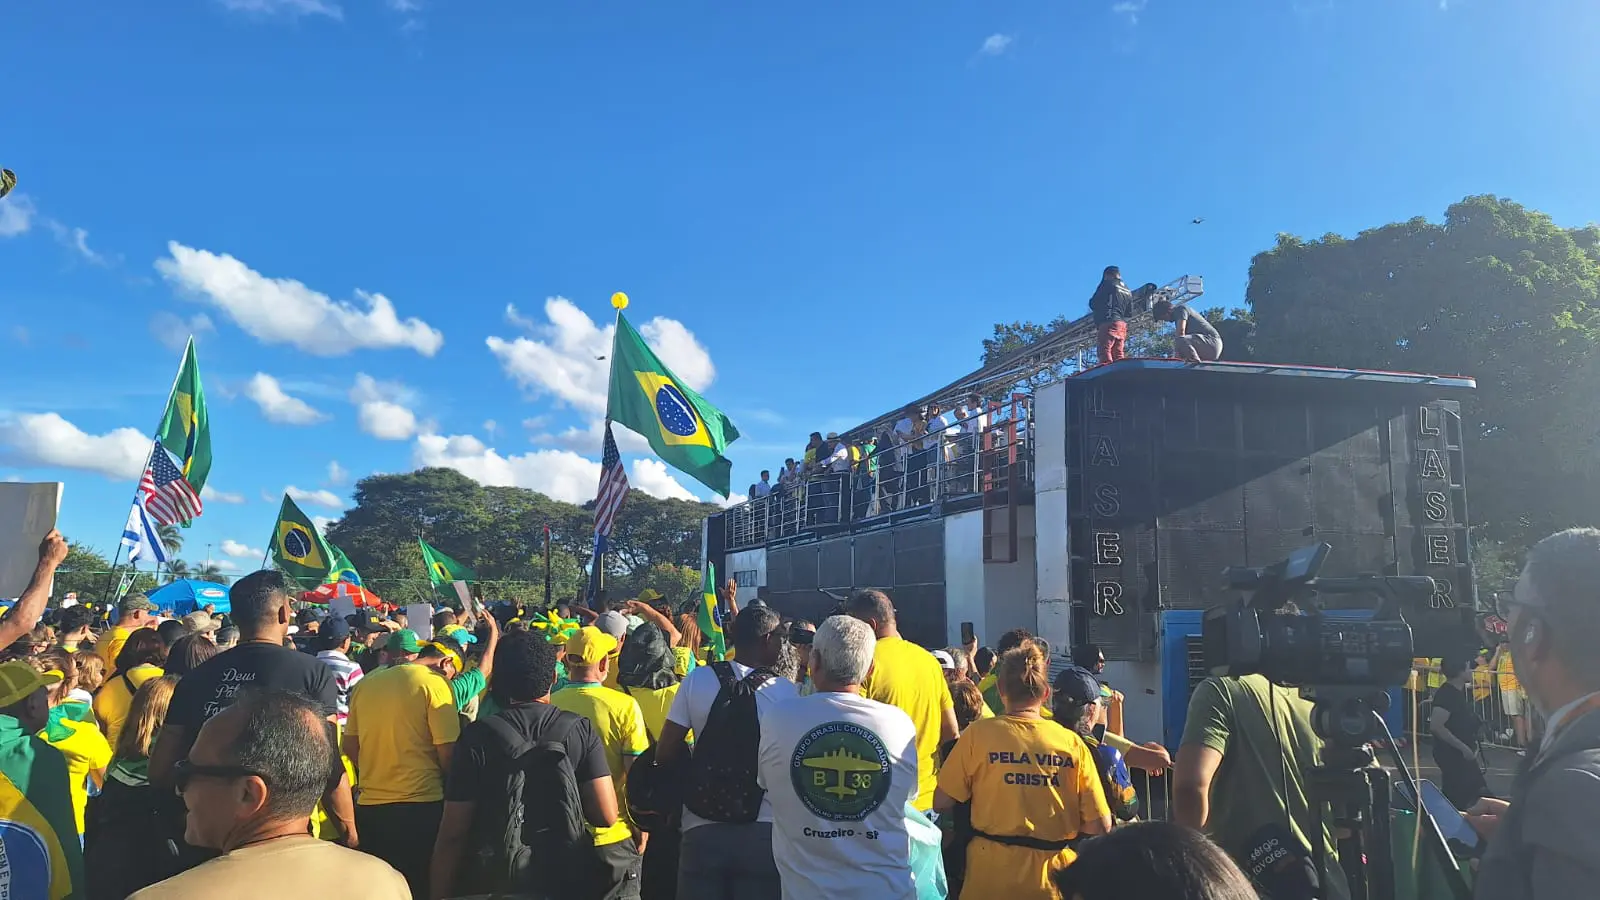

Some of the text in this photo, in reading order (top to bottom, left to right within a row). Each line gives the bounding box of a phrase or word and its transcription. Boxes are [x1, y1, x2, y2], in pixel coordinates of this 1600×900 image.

[1092, 387, 1124, 616] LASER
[1419, 406, 1454, 609] LASER
[222, 667, 256, 681] Deus
[793, 724, 889, 773] GRUPO BRASIL CONSERVADOR
[989, 752, 1074, 768] PELA VIDA
[813, 771, 872, 789] B 38
[803, 827, 855, 840] Cruzeiro
